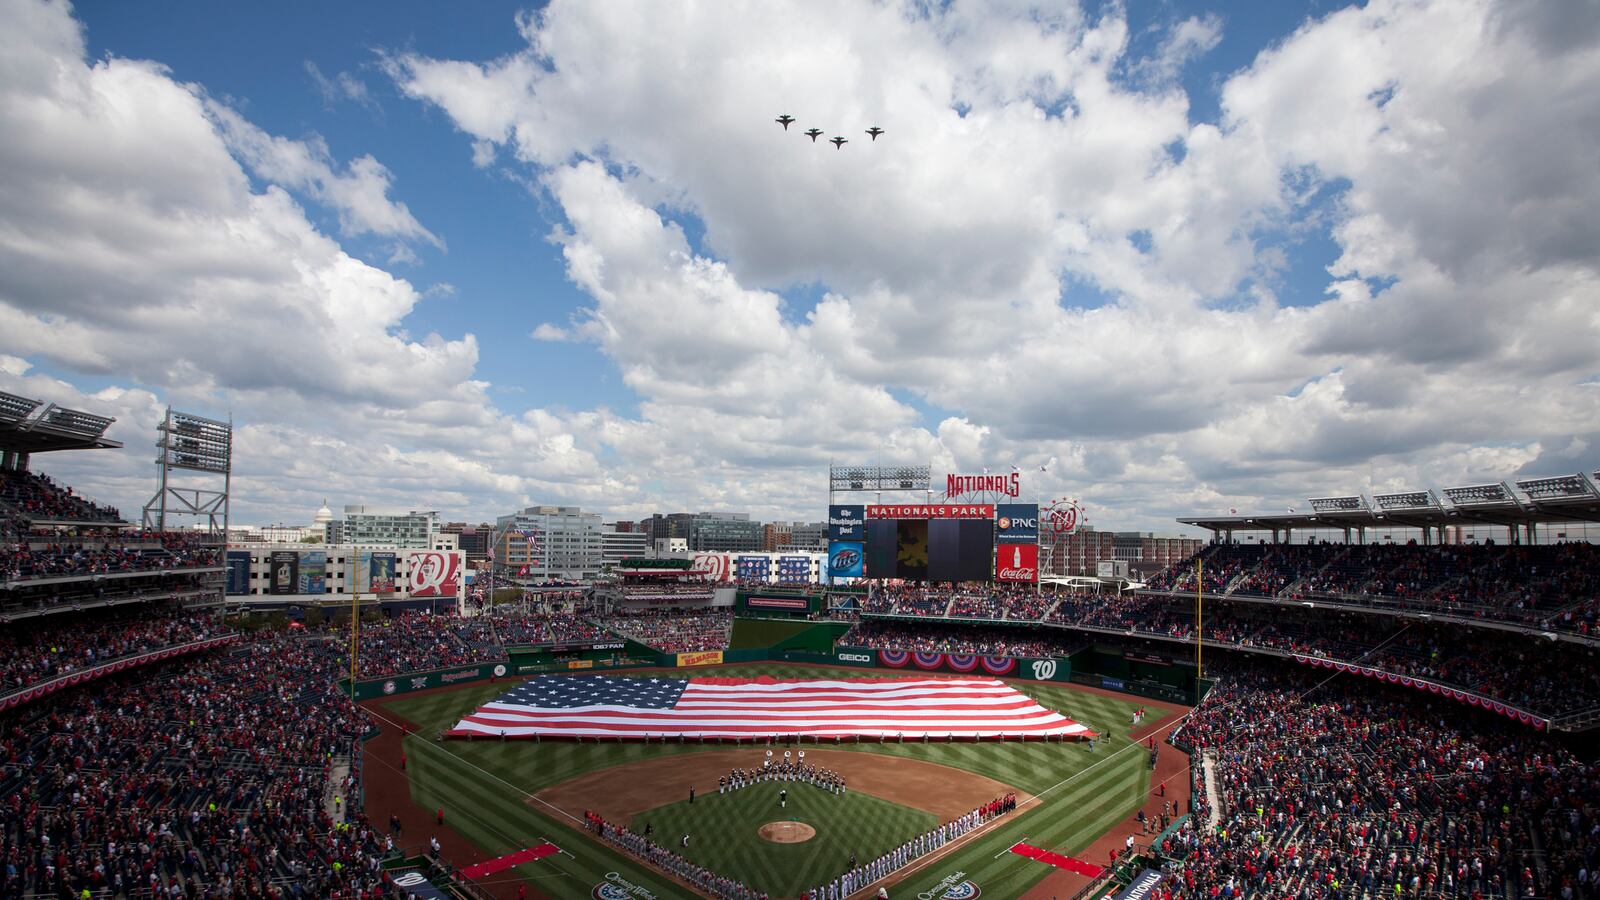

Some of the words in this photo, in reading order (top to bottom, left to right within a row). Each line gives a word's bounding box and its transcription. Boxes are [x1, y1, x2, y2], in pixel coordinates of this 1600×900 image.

[947, 473, 1019, 497] NATIONALS
[871, 507, 945, 515] NATIONALS
[952, 507, 986, 515] PARK
[1012, 518, 1037, 528] PNC
[838, 653, 870, 662] GEICO
